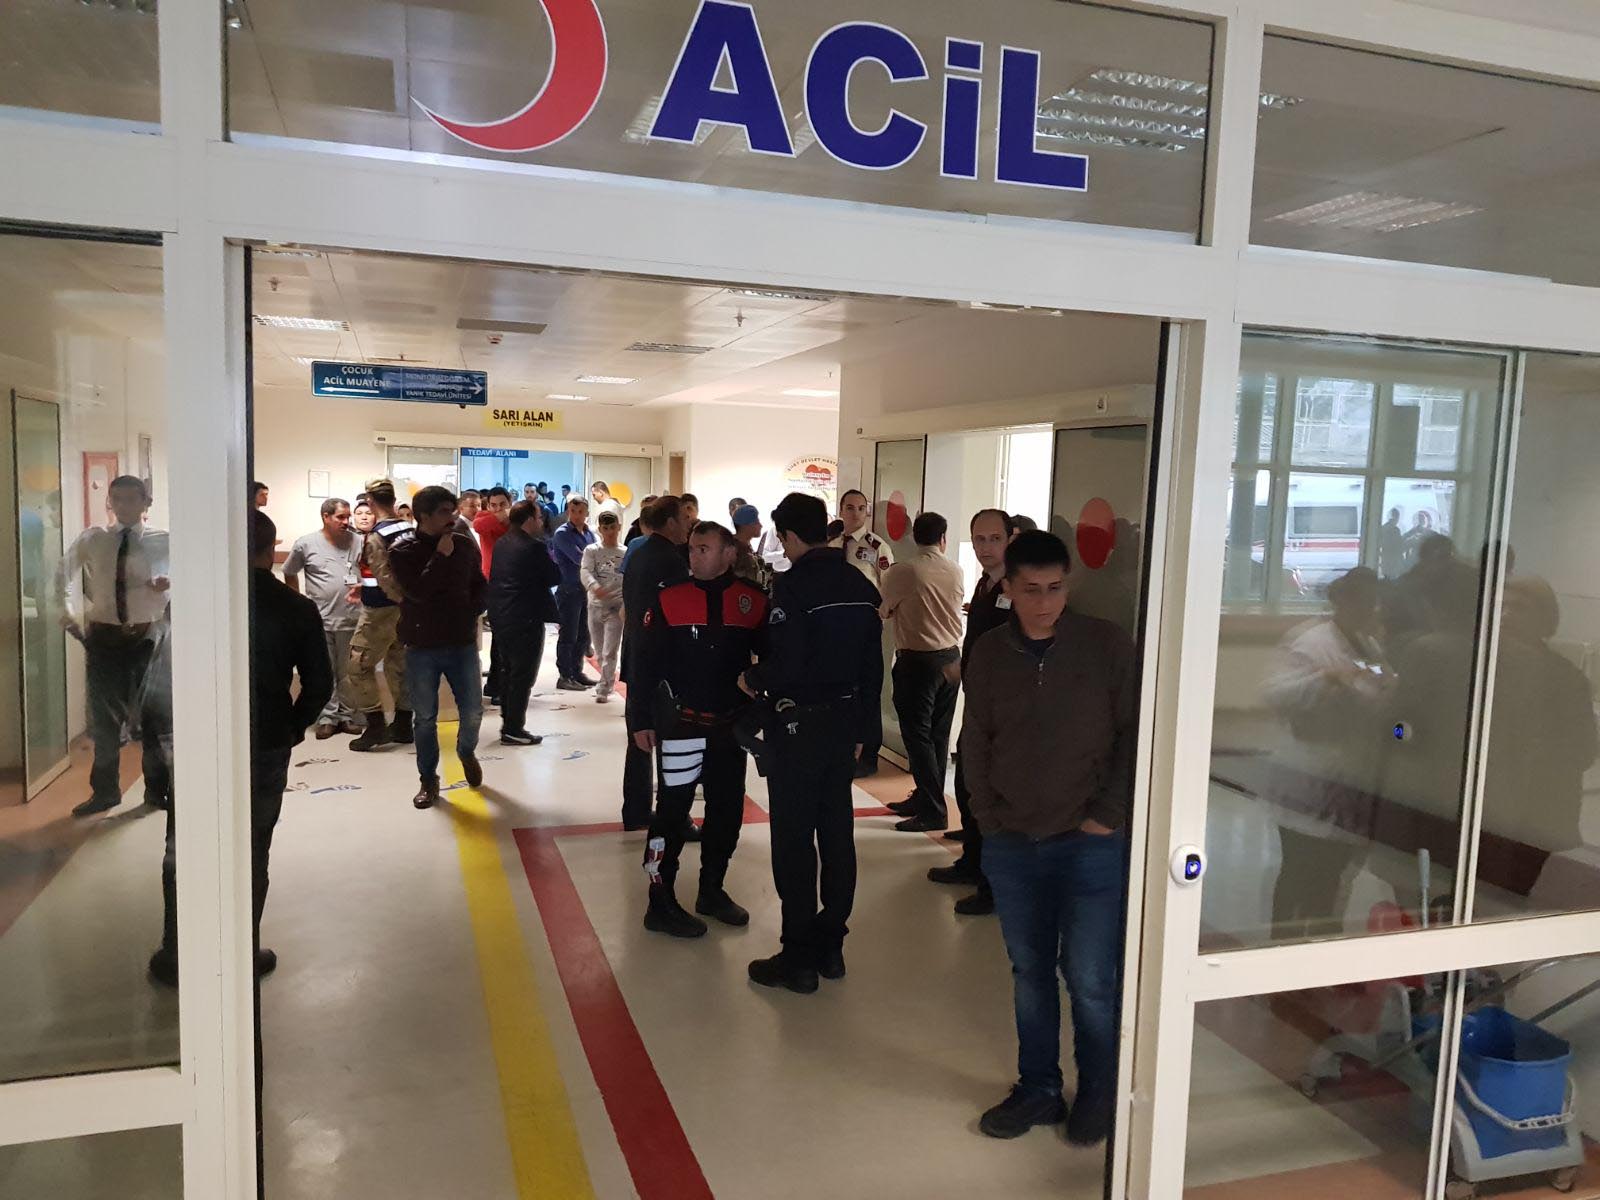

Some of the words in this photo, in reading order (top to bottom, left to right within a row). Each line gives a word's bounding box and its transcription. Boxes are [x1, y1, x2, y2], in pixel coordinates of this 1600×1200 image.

[341, 366, 374, 375] ÇOCUK
[323, 376, 344, 385] ACİL
[346, 377, 392, 388] MUAYENE
[493, 409, 520, 421] SARI
[523, 410, 554, 422] ALAN
[468, 448, 492, 456] TEDAVİ
[495, 449, 517, 457] ALANI
